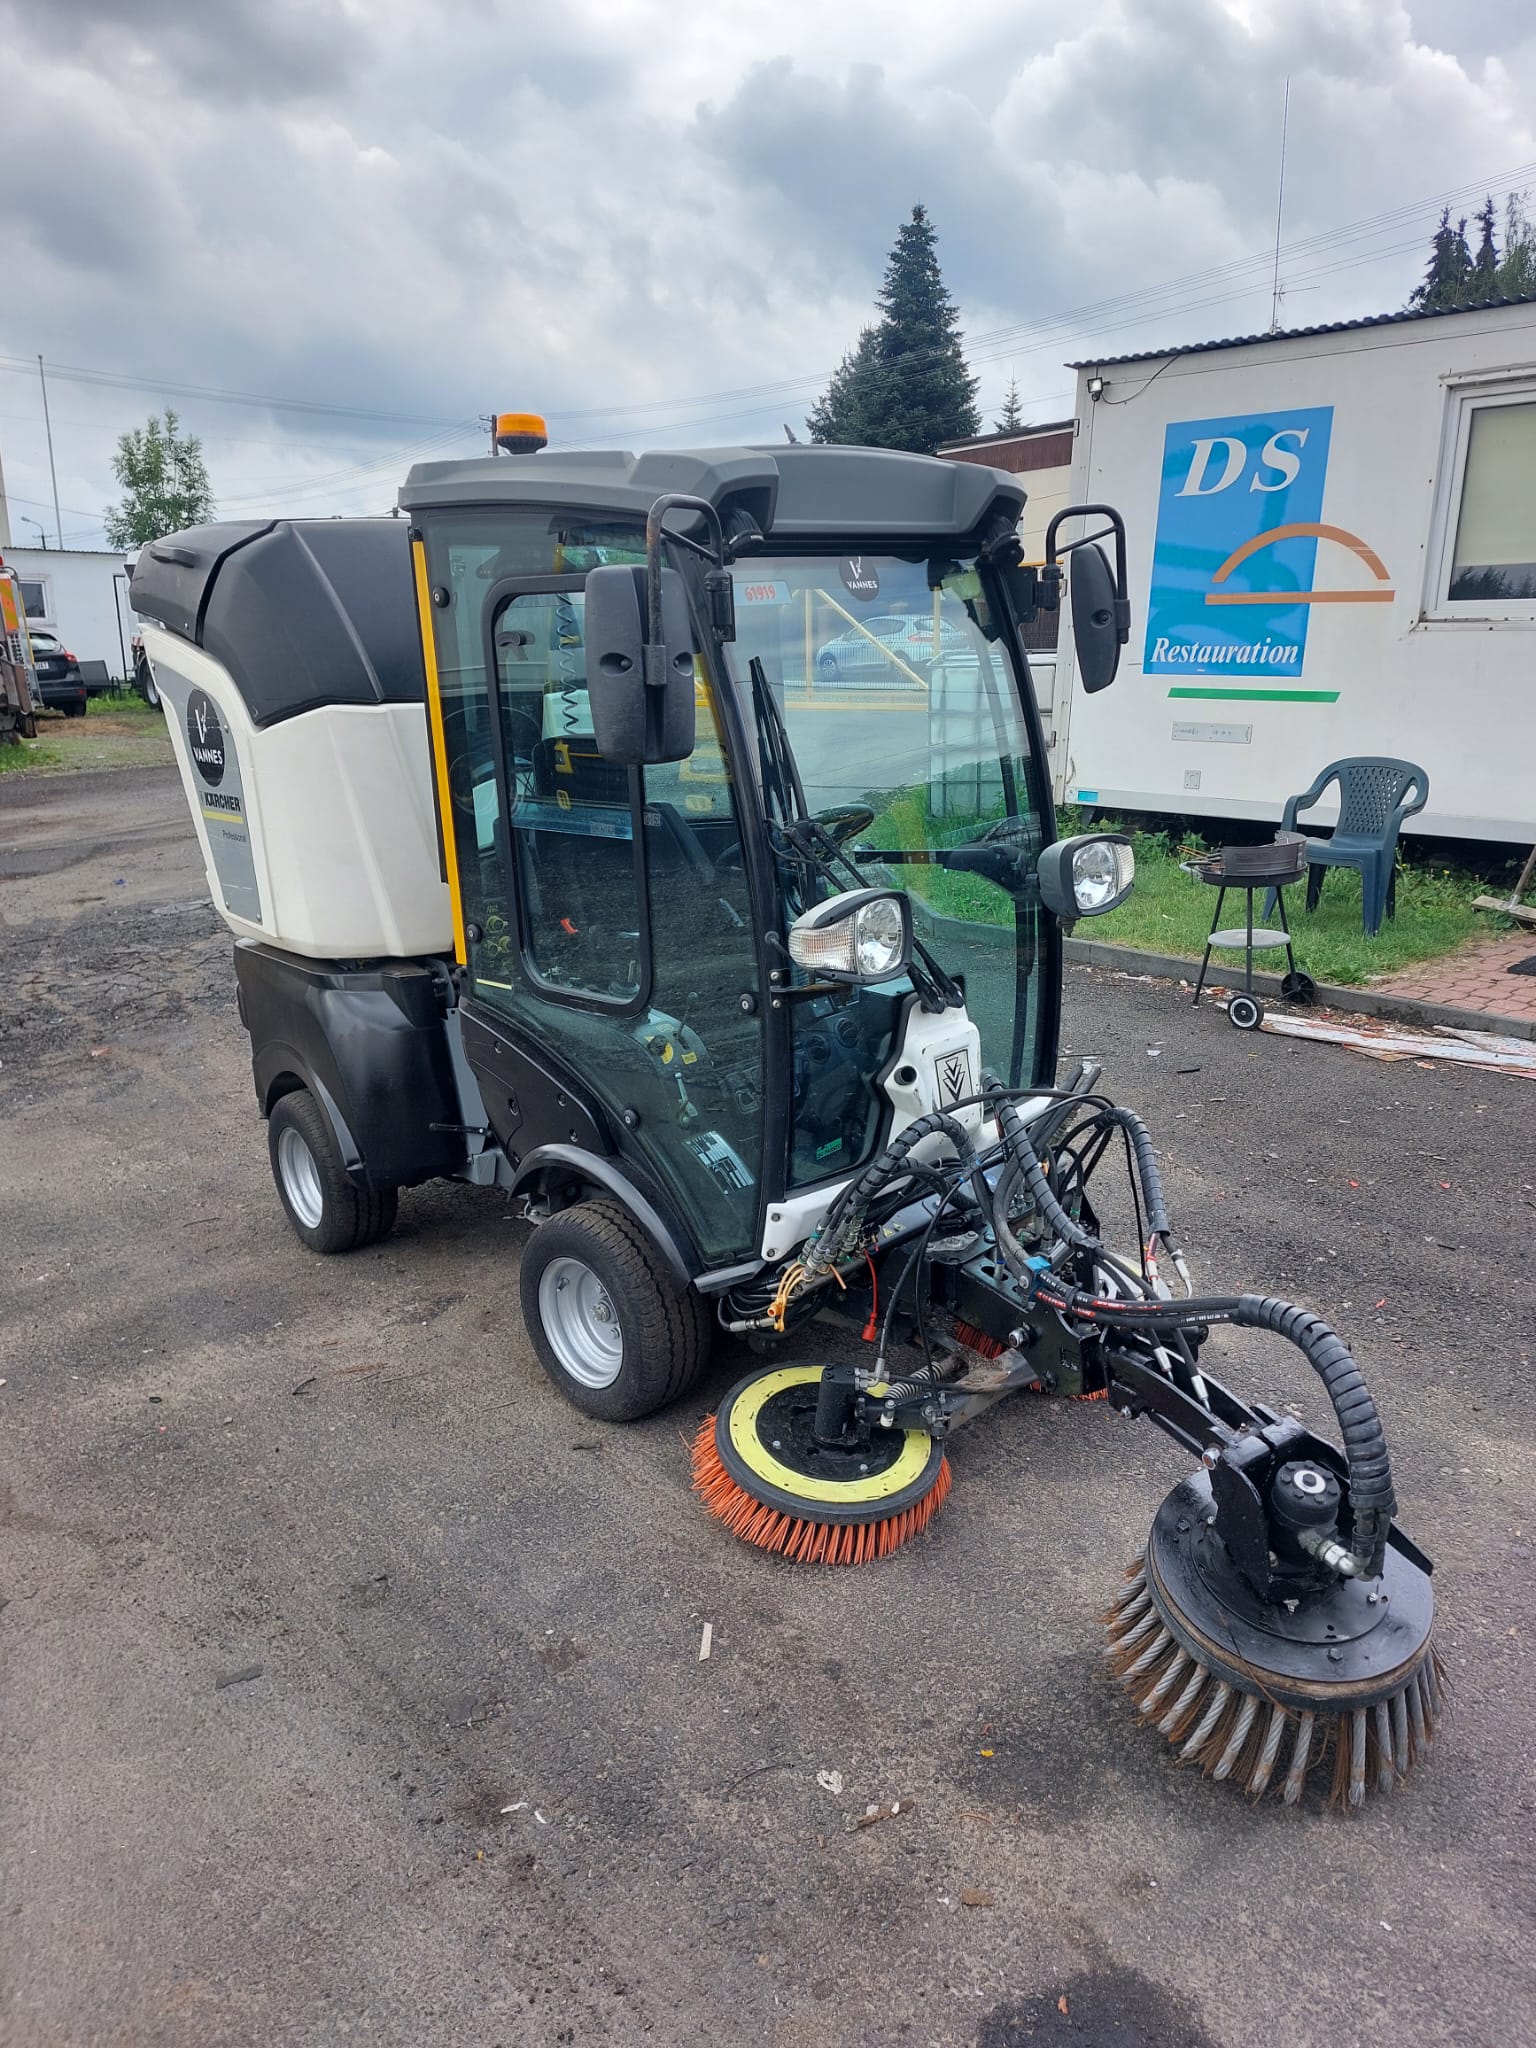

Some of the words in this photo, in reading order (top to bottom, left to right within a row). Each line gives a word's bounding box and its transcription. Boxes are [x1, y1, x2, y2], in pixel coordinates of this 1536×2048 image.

[1174, 428, 1310, 497] DS
[744, 584, 776, 602] 61919
[846, 579, 879, 590] VANNES
[1149, 636, 1299, 665] Restauration
[193, 746, 223, 765] VANNES
